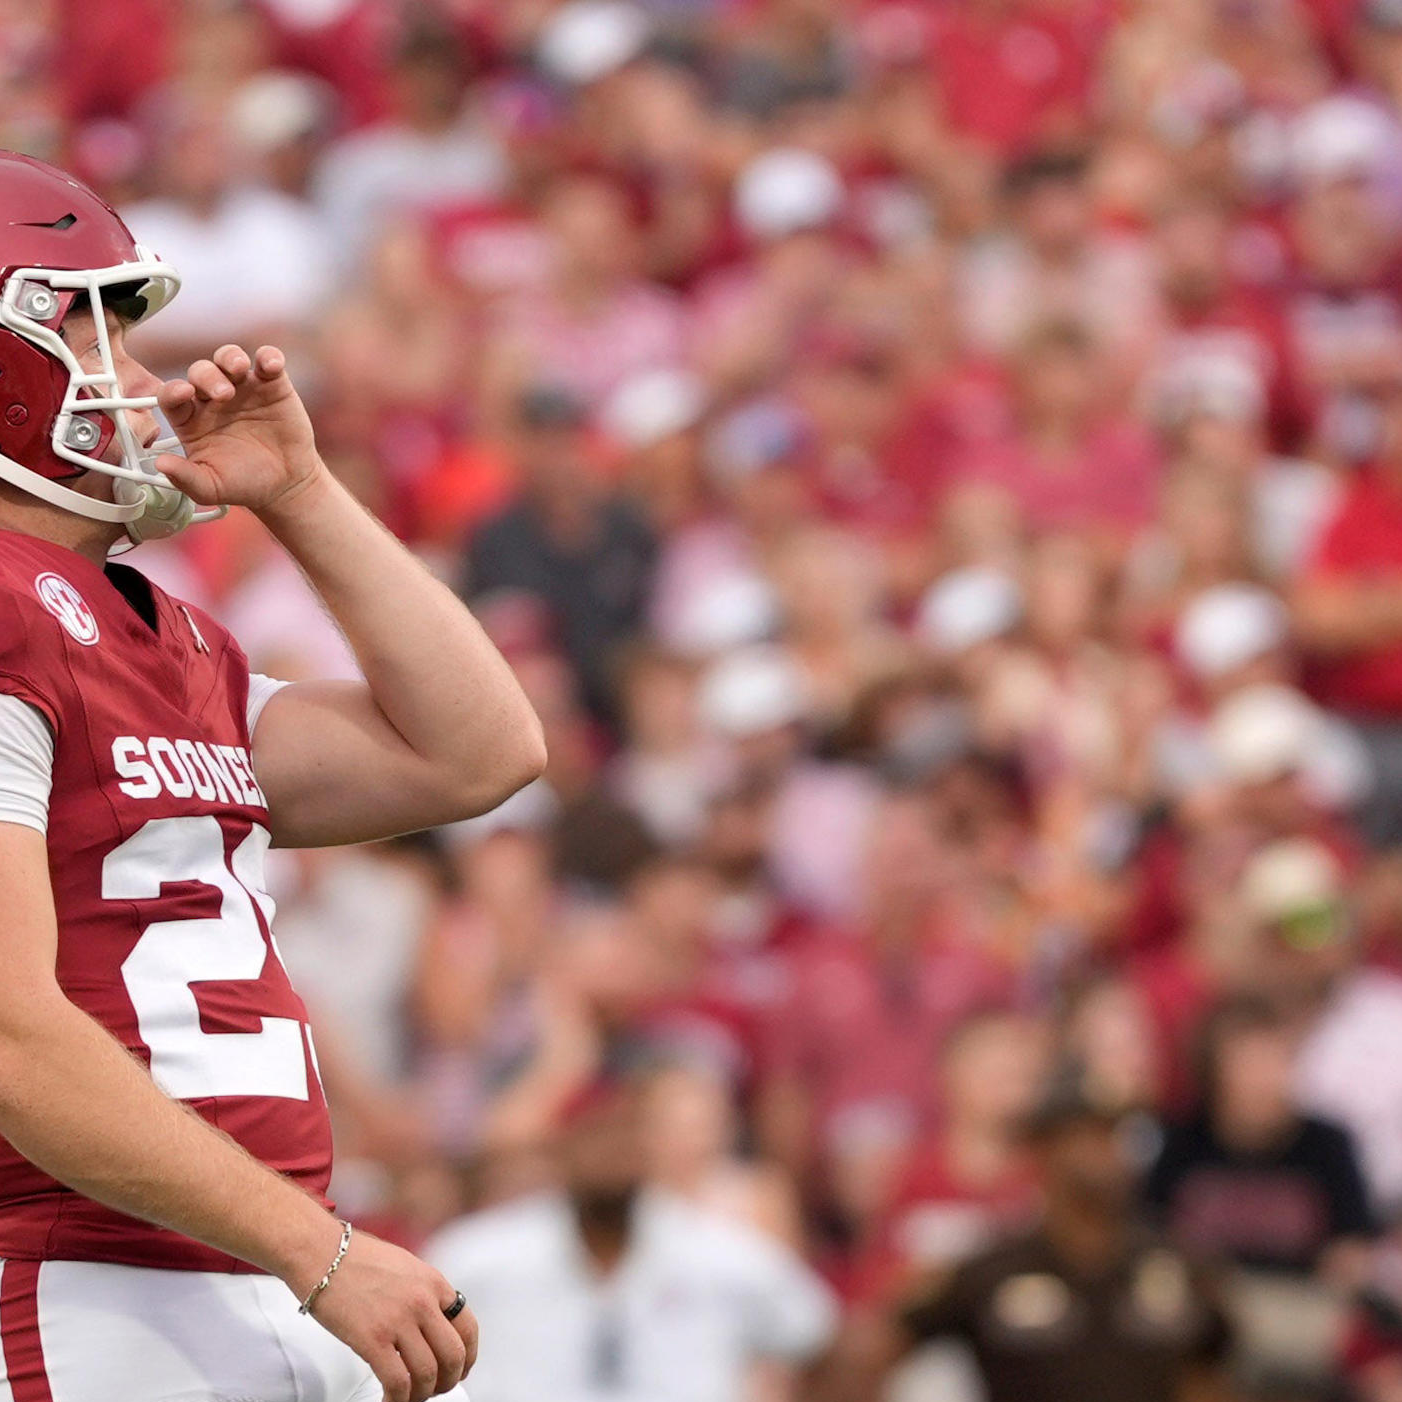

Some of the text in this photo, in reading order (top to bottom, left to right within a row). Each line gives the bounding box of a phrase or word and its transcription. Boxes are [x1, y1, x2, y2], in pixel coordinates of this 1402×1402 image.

[40, 577, 95, 640] SEC
[111, 735, 270, 812] SOONE
[100, 814, 328, 1109] 2
